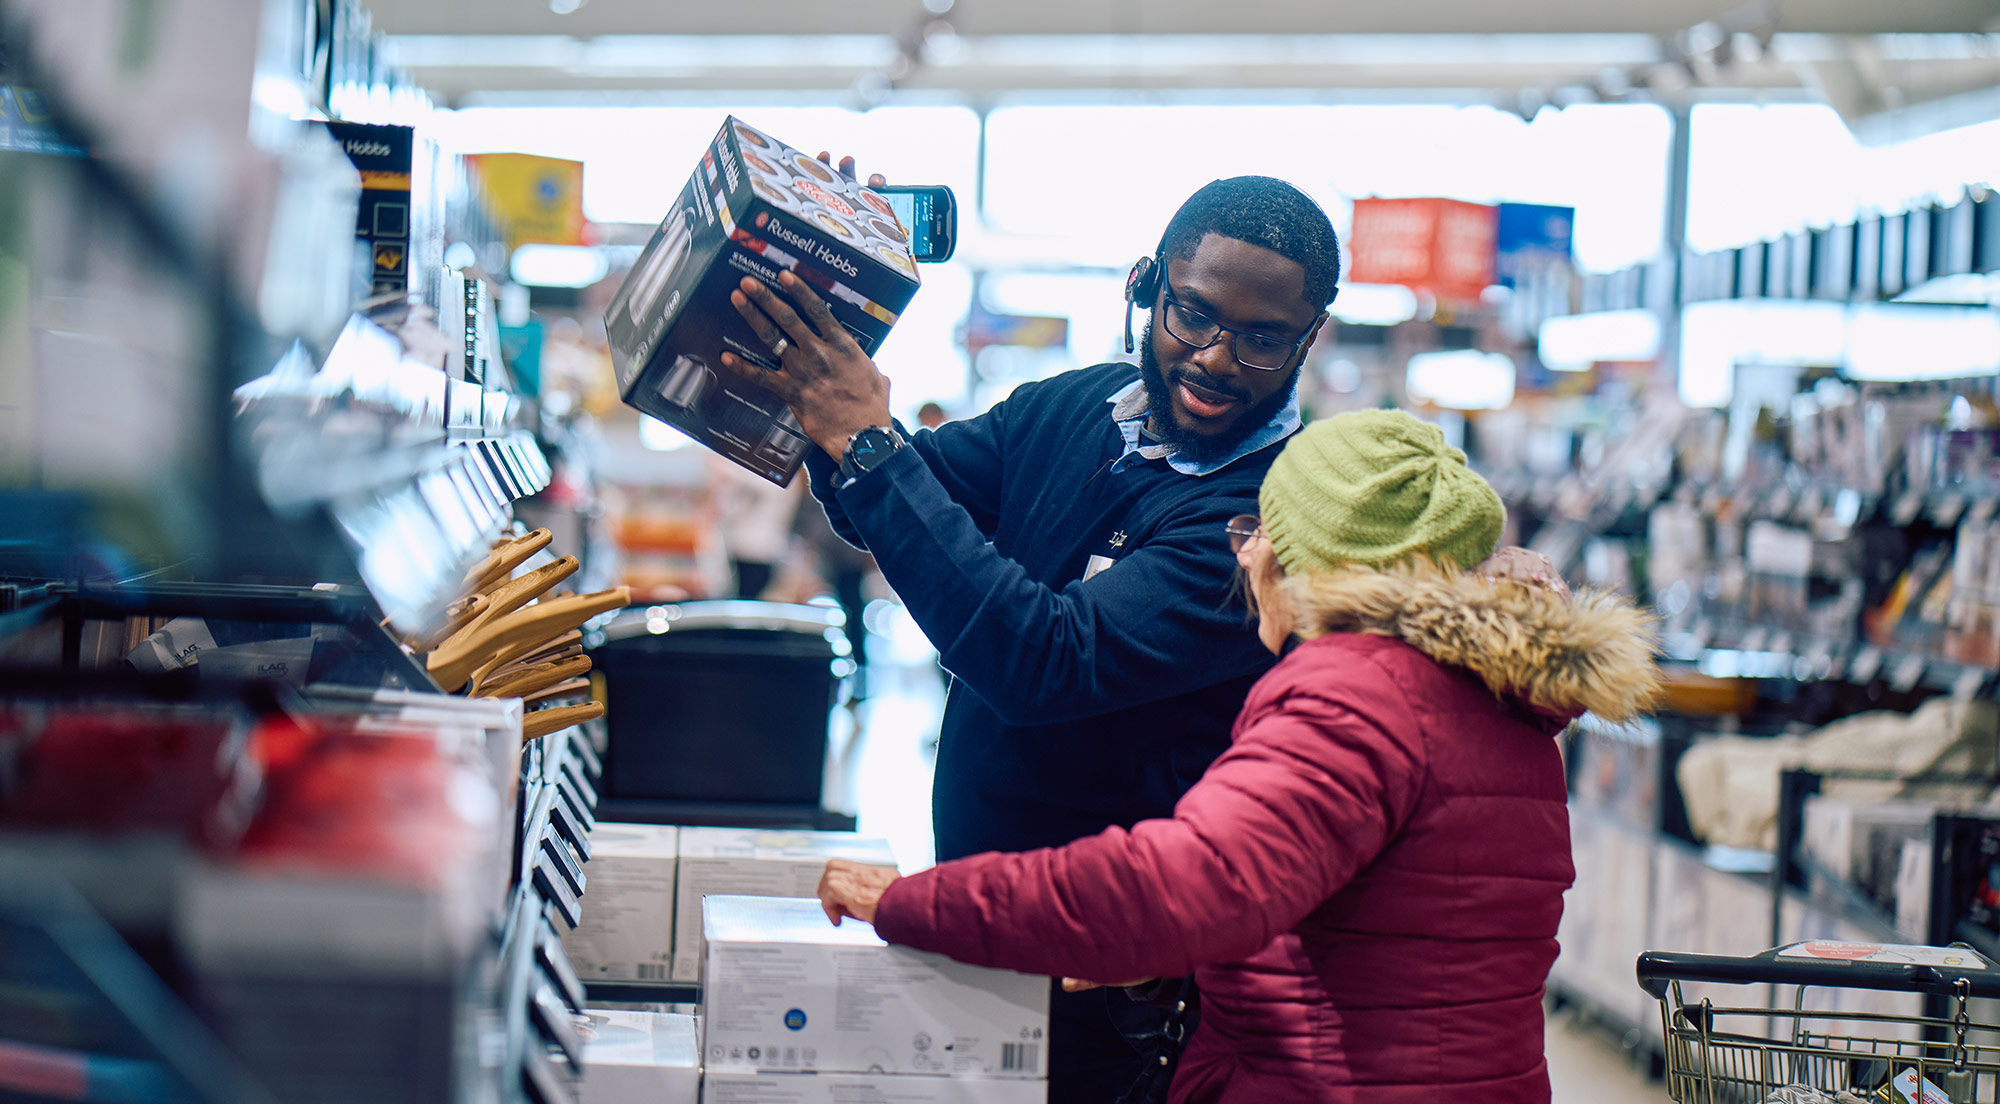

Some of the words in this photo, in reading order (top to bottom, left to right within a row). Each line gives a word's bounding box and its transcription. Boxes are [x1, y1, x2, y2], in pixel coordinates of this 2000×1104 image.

[346, 139, 391, 156] Hobbs
[717, 131, 734, 170] Russell
[724, 157, 740, 195] Hobbs
[767, 218, 816, 254] Russell
[815, 244, 858, 277] Hobbs
[732, 251, 777, 280] STAINLESS
[175, 644, 198, 662] ILAG
[257, 662, 287, 672] ILAG
